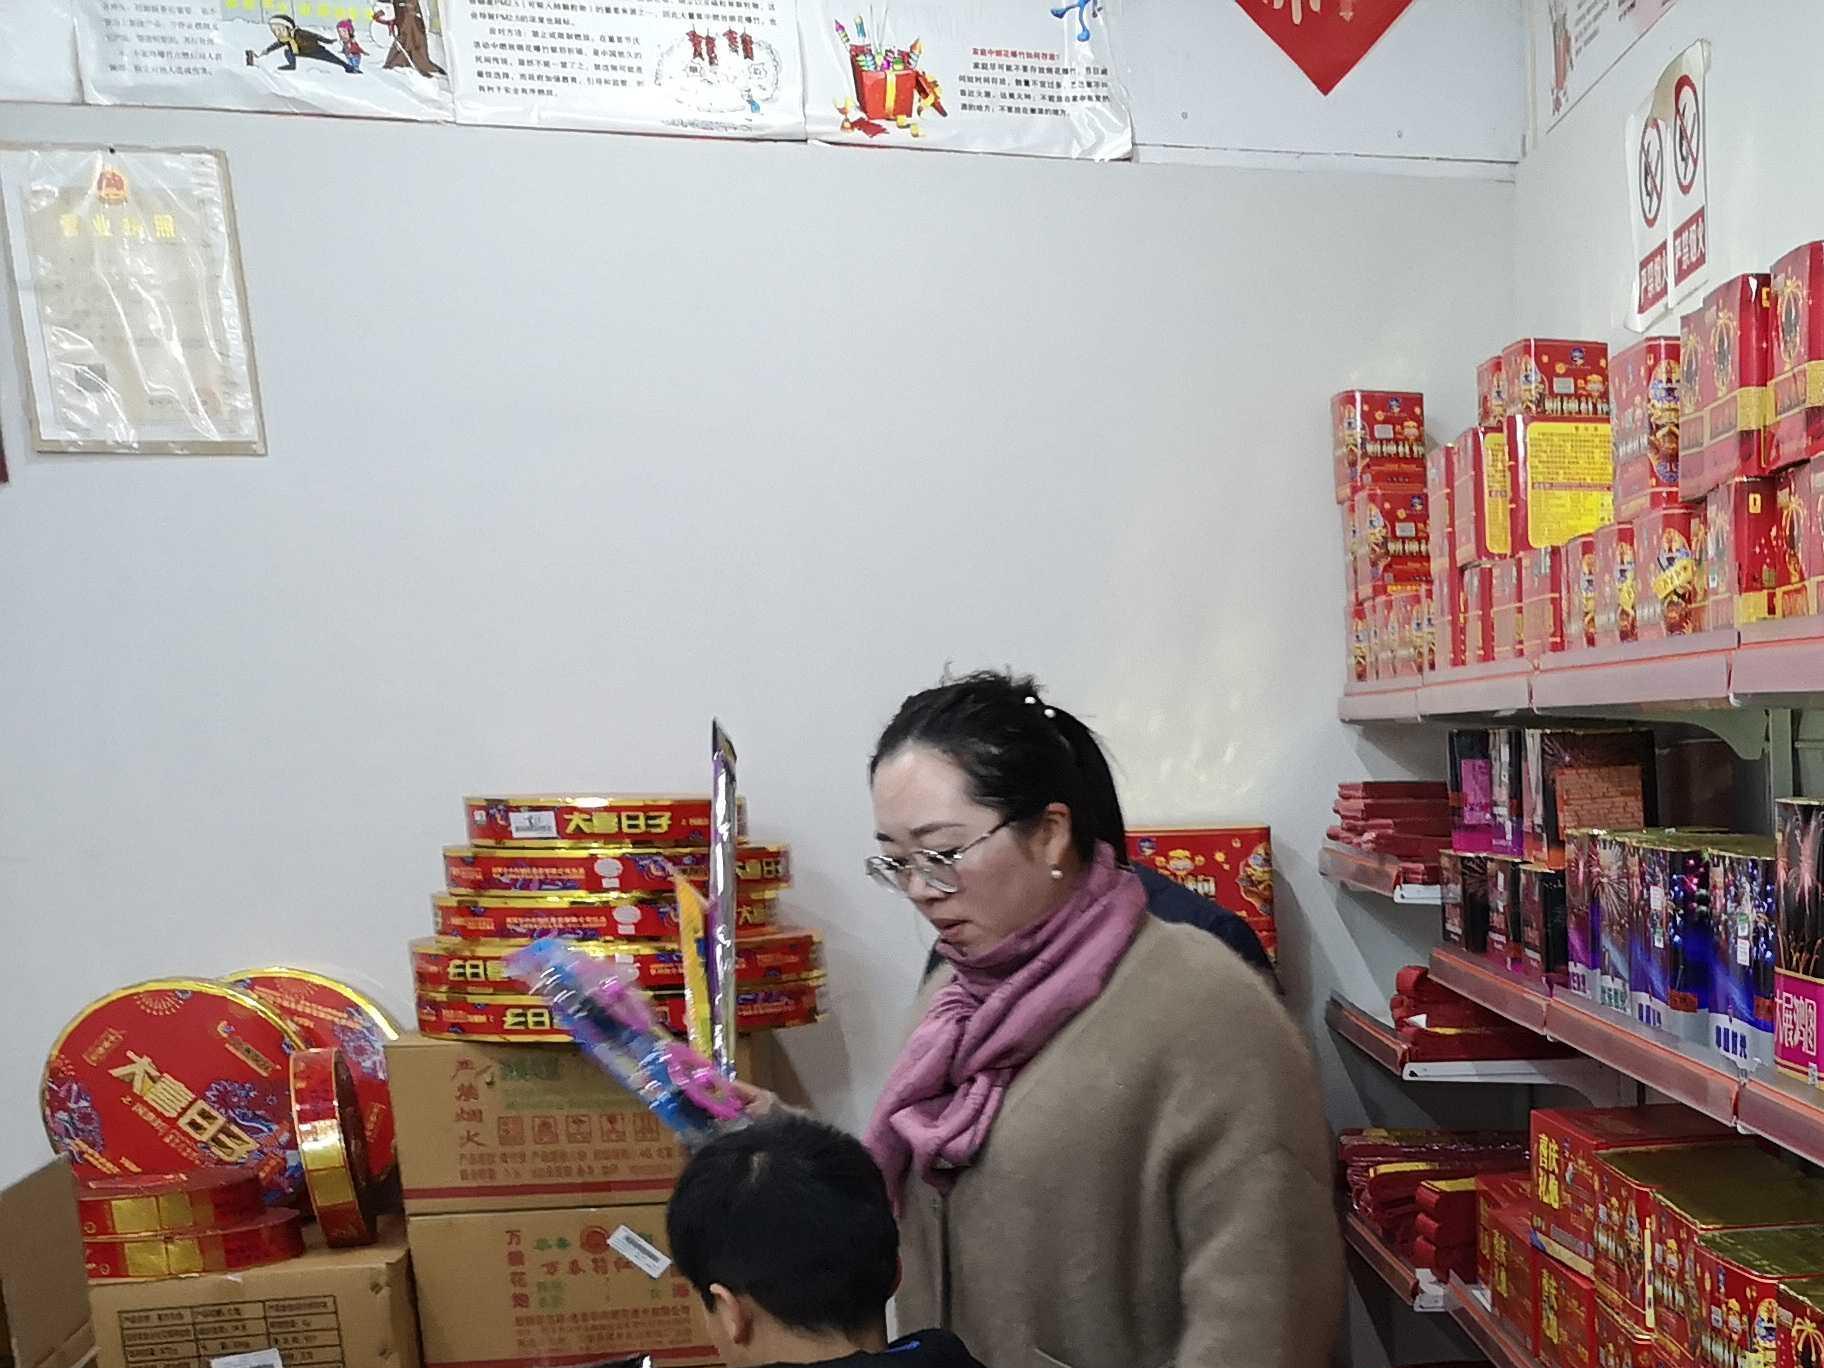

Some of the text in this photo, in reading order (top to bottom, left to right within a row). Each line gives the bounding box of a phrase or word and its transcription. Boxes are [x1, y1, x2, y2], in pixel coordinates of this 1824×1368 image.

[1674, 215, 1705, 280] 严禁烟火
[563, 810, 674, 835] 大喜日子
[108, 1049, 261, 1163] 大喜日子
[451, 1056, 487, 1148] 严禁烟火
